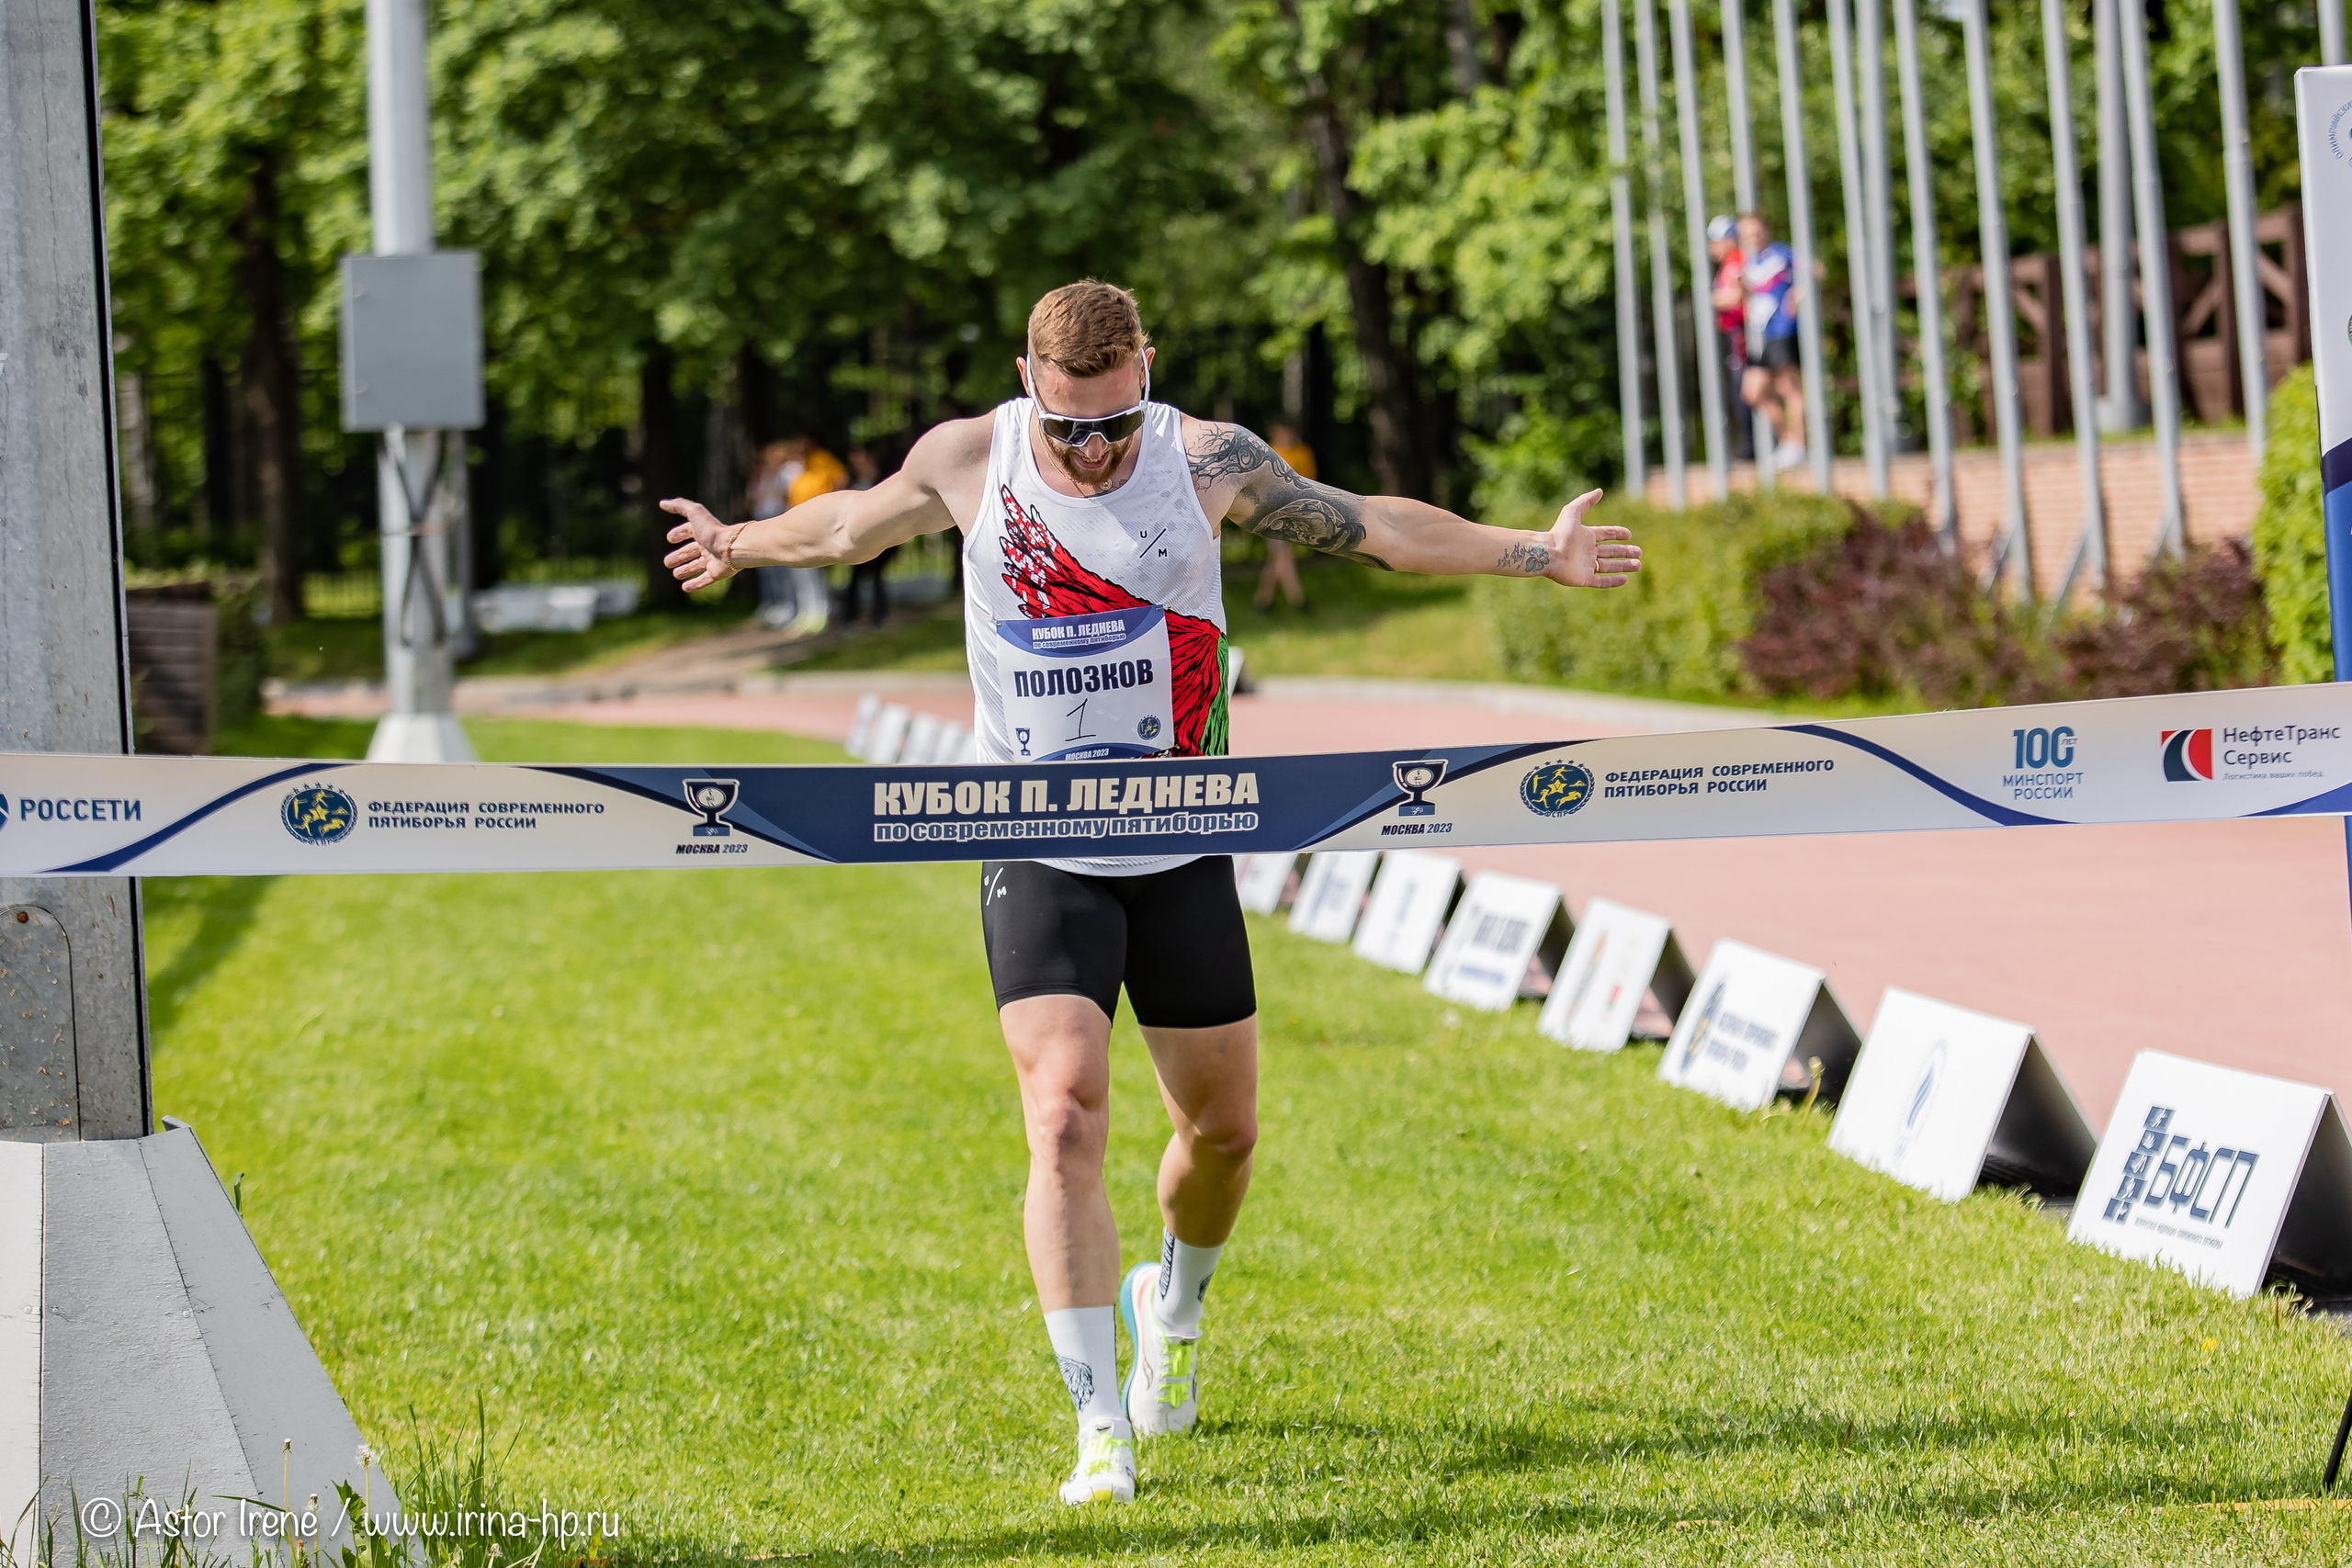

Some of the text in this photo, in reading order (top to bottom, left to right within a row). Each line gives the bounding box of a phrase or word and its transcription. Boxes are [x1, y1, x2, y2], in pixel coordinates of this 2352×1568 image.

[2328, 100, 2352, 160] ОЛИМПИЙСКИ
[1032, 619, 1125, 640] КУБОК П. ЛЕДНЕВА
[1033, 632, 1127, 649] по современному пятиборью
[1013, 659, 1154, 698] ПОЛОЗКОВ
[1065, 698, 1097, 742] 1
[2223, 725, 2341, 747] НефтеТранс
[1065, 748, 1110, 761] МОСКВА 2023
[2012, 726, 2075, 769] 100
[2223, 750, 2293, 770] Сервис
[1605, 759, 1835, 784] ФЕДЕРАЦИЯ СОВРЕМЕННОГО
[2003, 773, 2084, 787] МИНСПОРТ
[874, 773, 1260, 816] КУБОК П. ЛЕДНЕВА
[1604, 779, 1768, 798] ПЯТИБОРЬЯ РОССИИ
[2014, 786, 2074, 800] РОССИИ
[20, 797, 142, 821] РОССЕТИ
[368, 801, 605, 815] ФЕДЕРАЦИЯ СОВРЕМЕННОГО
[368, 816, 537, 829] ПЯТИБОРЬЯ РОССИИ
[874, 811, 1260, 842] по современному пятиборью
[1381, 823, 1453, 836] МОСКВА 2023
[675, 843, 749, 854] МОСКВА 2023
[2143, 1134, 2260, 1229] БФСП
